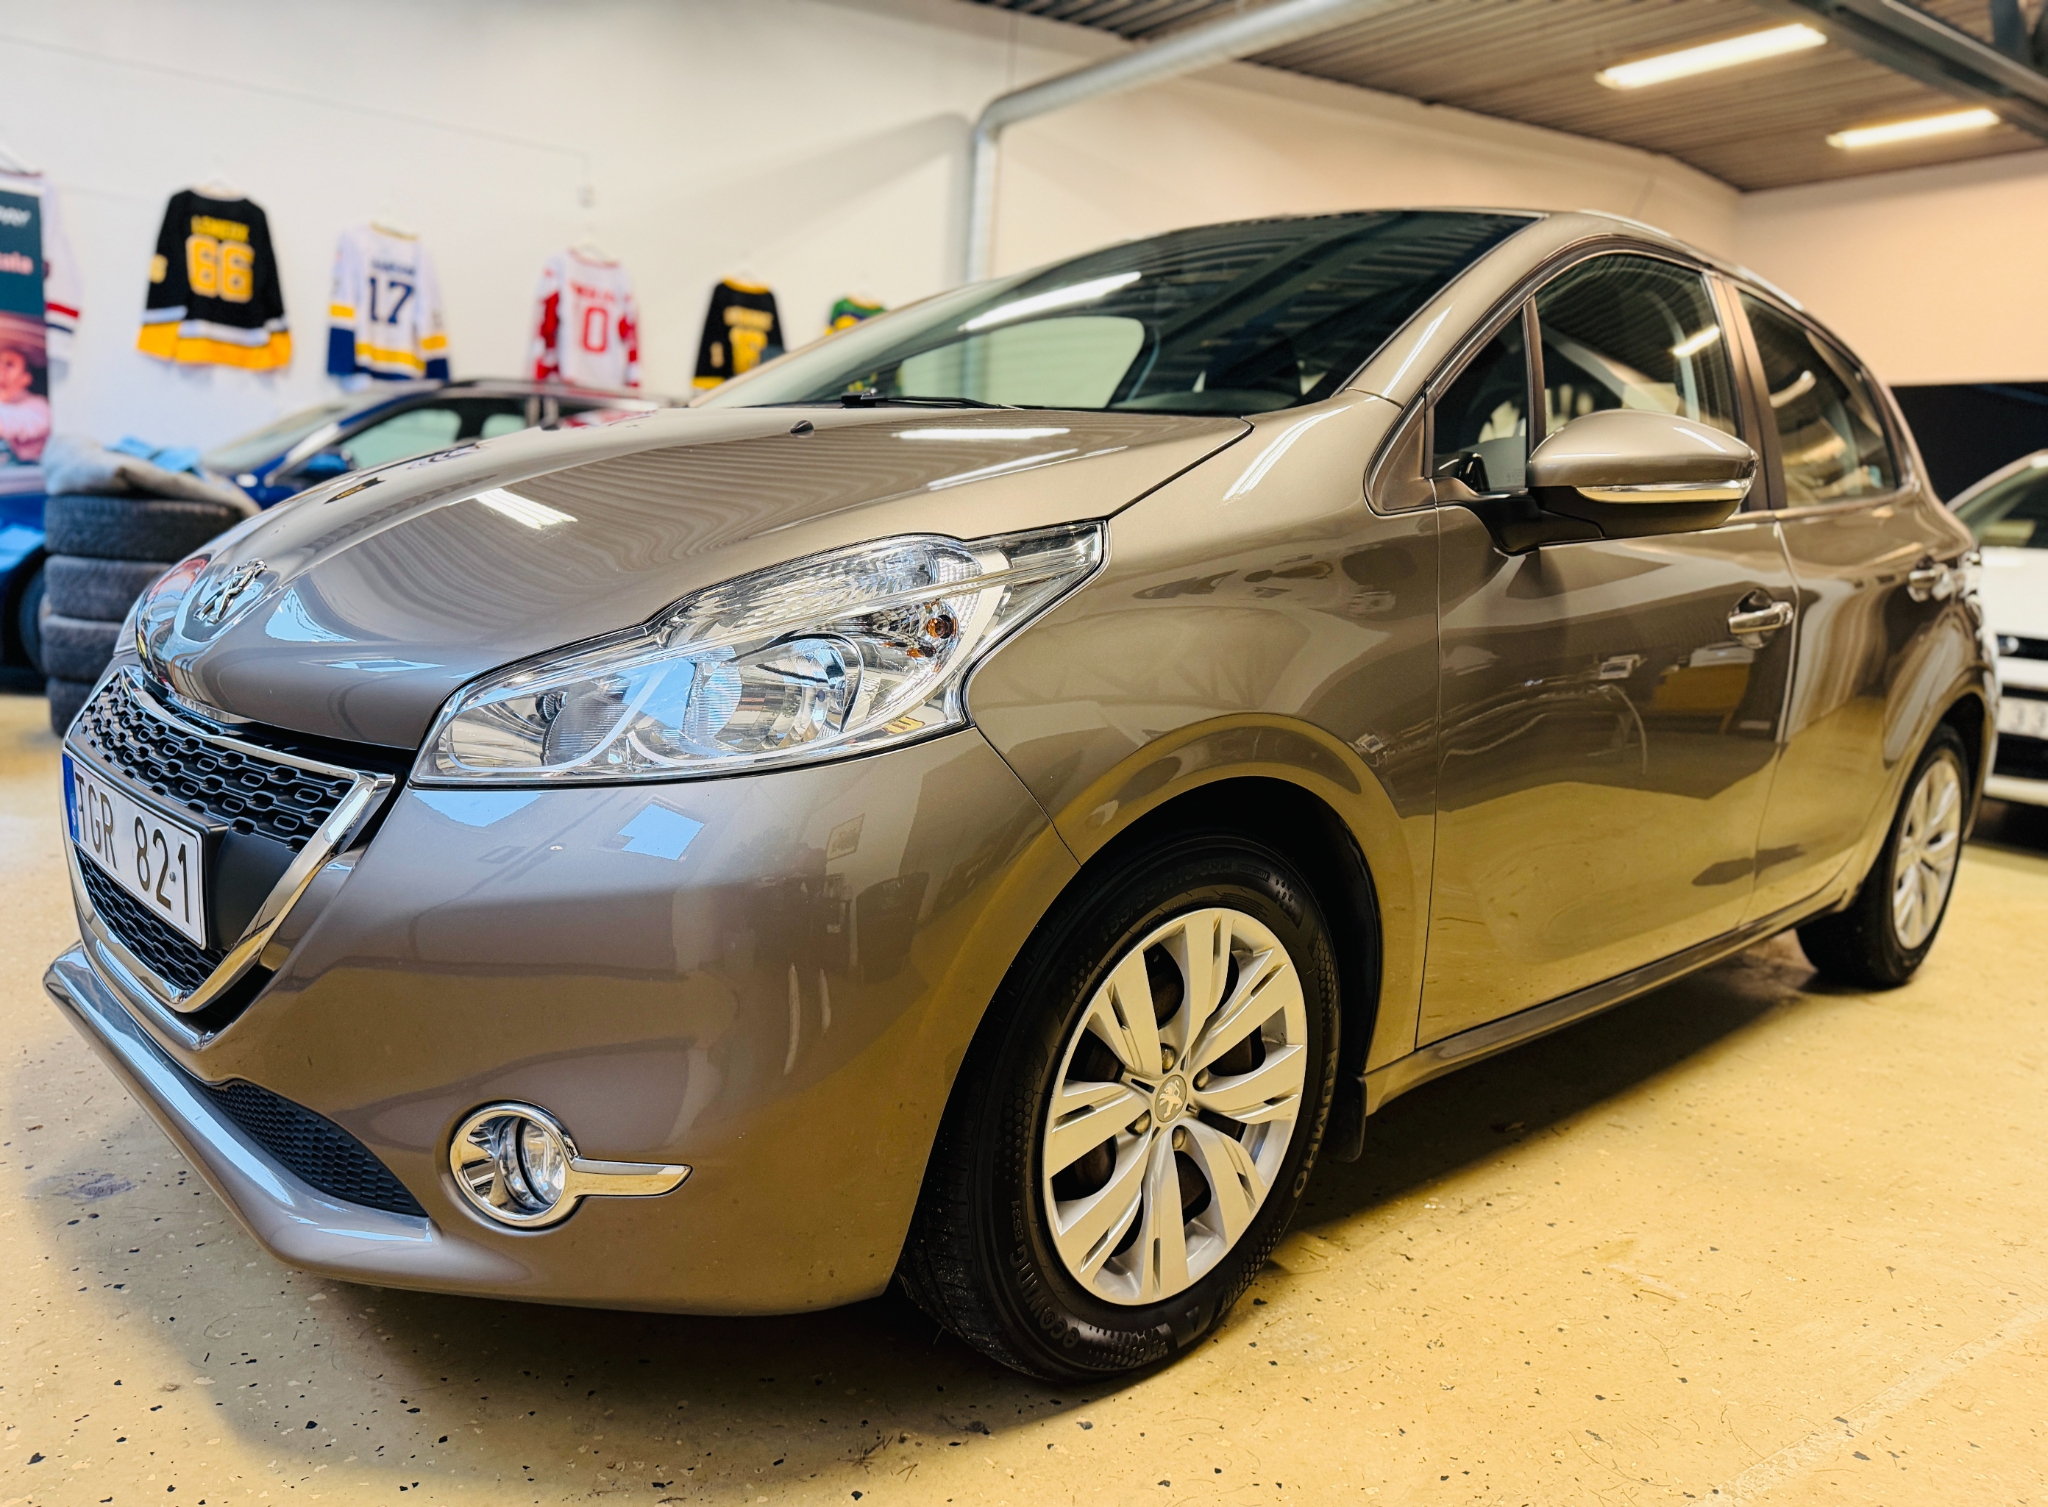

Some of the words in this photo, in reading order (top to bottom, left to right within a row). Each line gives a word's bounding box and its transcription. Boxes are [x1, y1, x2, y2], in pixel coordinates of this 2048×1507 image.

[186, 234, 255, 304] 66
[369, 277, 415, 325] 17
[75, 771, 118, 870] TGR
[134, 816, 190, 925] 821
[1293, 1048, 1338, 1198] KUMHO
